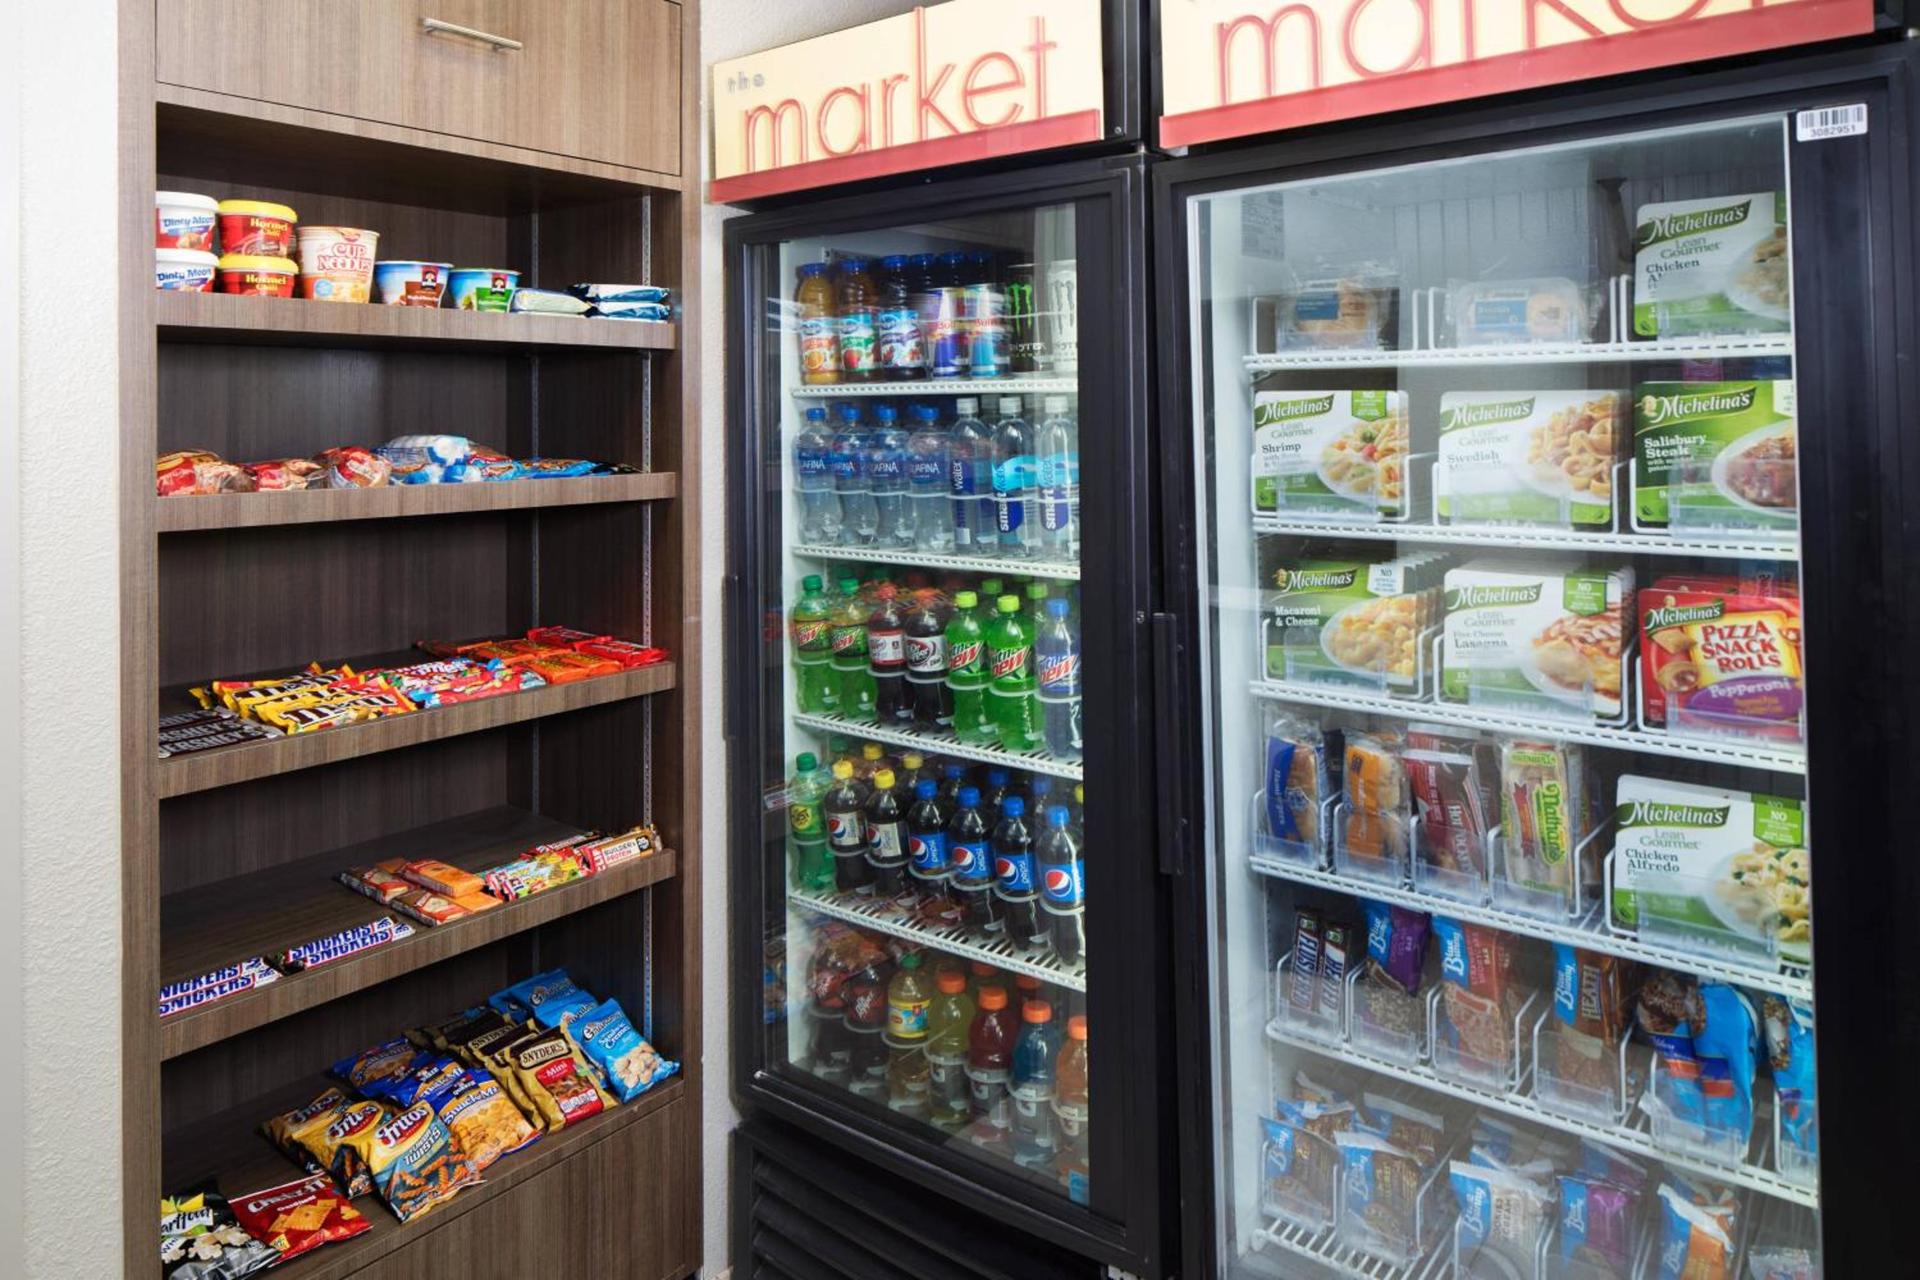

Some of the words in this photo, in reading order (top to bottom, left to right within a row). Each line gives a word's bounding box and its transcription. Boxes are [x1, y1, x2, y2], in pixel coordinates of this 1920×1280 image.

[727, 71, 765, 93] the
[744, 5, 1058, 172] market
[250, 217, 289, 231] Hormel
[1640, 204, 1745, 245] Michelina's
[332, 242, 367, 257] CUP
[1660, 241, 1720, 259] Gourmet
[1676, 237, 1707, 249] Lean
[316, 256, 372, 274] NOODLES
[1646, 259, 1700, 274] Chicken
[1256, 399, 1330, 425] Michelina's
[1441, 403, 1530, 431] Michelina's
[1650, 393, 1751, 424] Michelina's
[1270, 428, 1313, 438] Gourmet
[1643, 433, 1707, 449] Salisbury
[1262, 442, 1302, 454] Shrimp
[1447, 450, 1500, 463] Swedish
[1645, 446, 1690, 459] Steak
[1042, 488, 1056, 530] smart
[1281, 570, 1353, 593] Michelina's
[1447, 584, 1538, 611] Michelina's
[1275, 605, 1321, 616] Macaroni
[1644, 604, 1721, 630] Michelina's
[1275, 618, 1284, 627] &
[1285, 616, 1320, 626] Cheese
[1463, 616, 1516, 628] Gourmet
[1701, 620, 1769, 643] PIZZA
[1454, 638, 1509, 650] Lasagna
[1701, 637, 1778, 661] SNACK
[1716, 653, 1781, 674] ROLLS
[1620, 800, 1724, 826] Michelina's
[1771, 811, 1788, 821] NO
[1640, 835, 1700, 850] Gourmet
[1654, 829, 1686, 840] Lean
[1625, 848, 1679, 862] Chicken
[1627, 860, 1680, 873] Alfredo
[292, 922, 372, 961] SNICKERS
[308, 928, 390, 965] SNICKERS
[545, 1062, 567, 1077] Mini
[375, 1106, 429, 1148] Fritos
